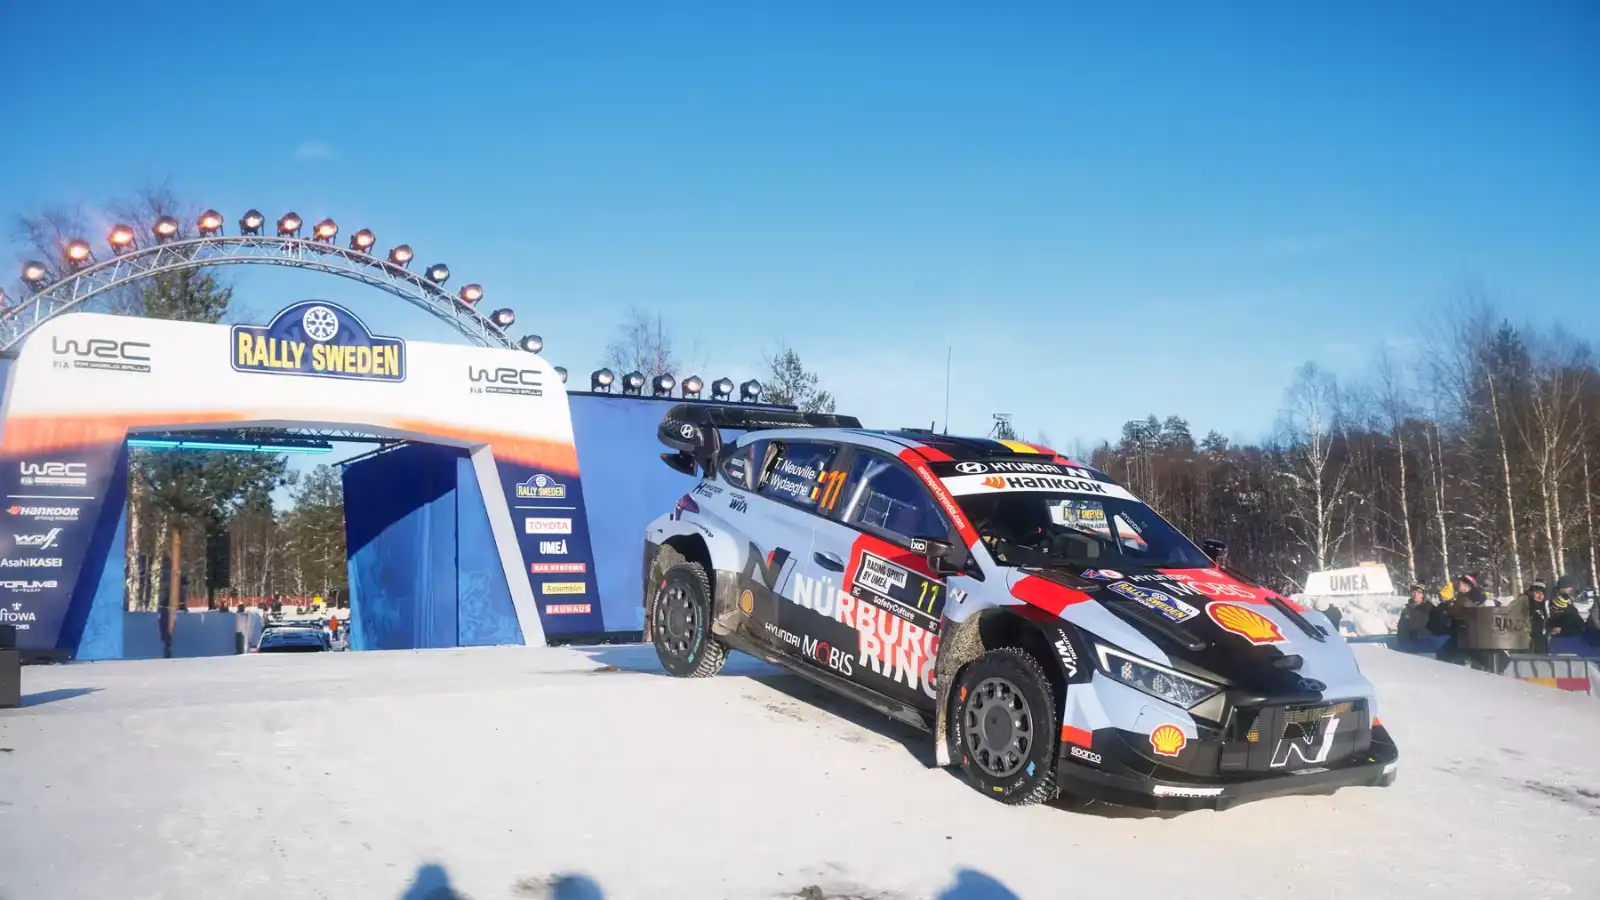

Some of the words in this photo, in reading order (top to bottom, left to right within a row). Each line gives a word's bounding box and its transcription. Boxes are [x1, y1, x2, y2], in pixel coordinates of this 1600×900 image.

[52, 335, 151, 361] WRC
[238, 331, 306, 369] RALLY
[312, 343, 399, 376] SWEDEN
[468, 365, 542, 386] WRC
[20, 461, 87, 476] WRC
[781, 460, 816, 480] Neuville
[989, 462, 1063, 475] HYUNDAI
[518, 486, 538, 496] RALLY
[538, 487, 564, 497] SWEDEN
[770, 473, 808, 497] Wydaeghe
[820, 470, 848, 510] 11
[917, 465, 965, 530] motorsport.hyundai.com
[528, 522, 568, 530] TOYOTA
[1120, 510, 1144, 534] HYUNDAI
[862, 571, 871, 582] BY
[866, 559, 887, 576] RACING
[887, 567, 906, 584] SPIRIT
[1128, 574, 1195, 582] HYUNDAI
[916, 580, 940, 614] 11
[1119, 582, 1148, 598] RALLY
[1146, 596, 1187, 619] SWEDEN
[1159, 581, 1257, 599] MOBIS
[547, 605, 591, 613] BAUHAUS
[872, 595, 916, 620] SafetyCulture
[764, 621, 801, 648] HYUNDAI
[802, 634, 854, 677] MOBIS
[1056, 628, 1078, 660] HYUNDAI
[1070, 746, 1102, 762] sparco
